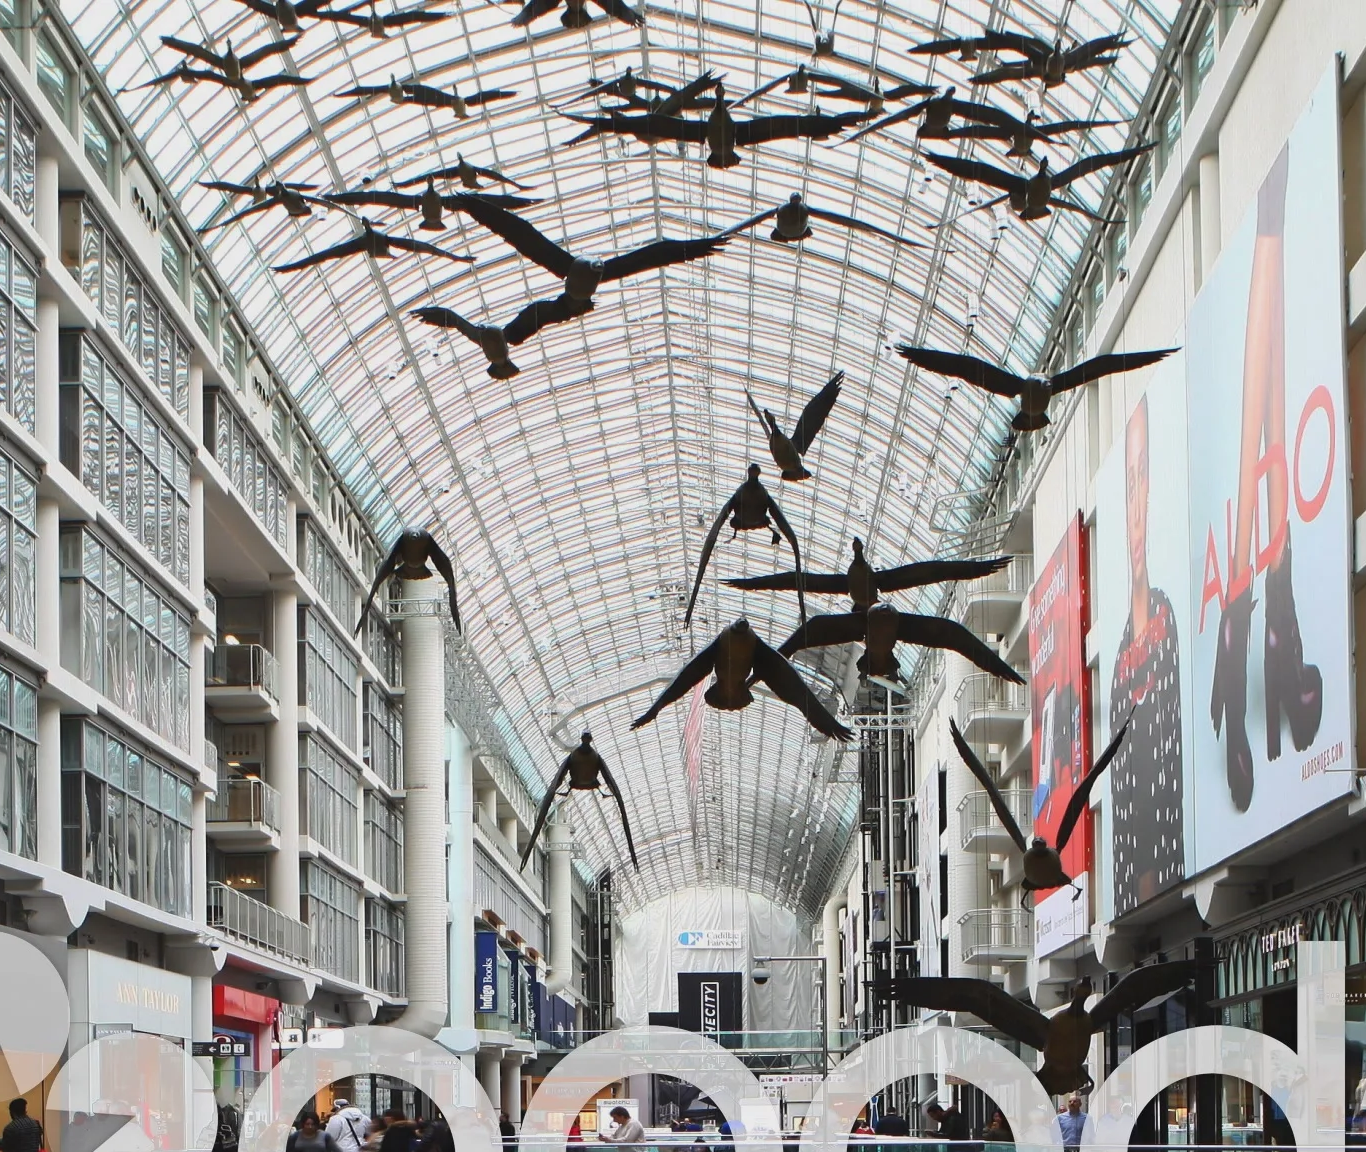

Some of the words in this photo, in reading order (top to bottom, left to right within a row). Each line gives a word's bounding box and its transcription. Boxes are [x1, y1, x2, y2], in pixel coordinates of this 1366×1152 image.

[1199, 385, 1336, 633] ALDO
[1262, 933, 1276, 954] TED
[483, 957, 493, 983] Books
[116, 982, 137, 1005] ANN
[142, 988, 179, 1013] TAYLOR
[480, 985, 494, 1010] Indigo
